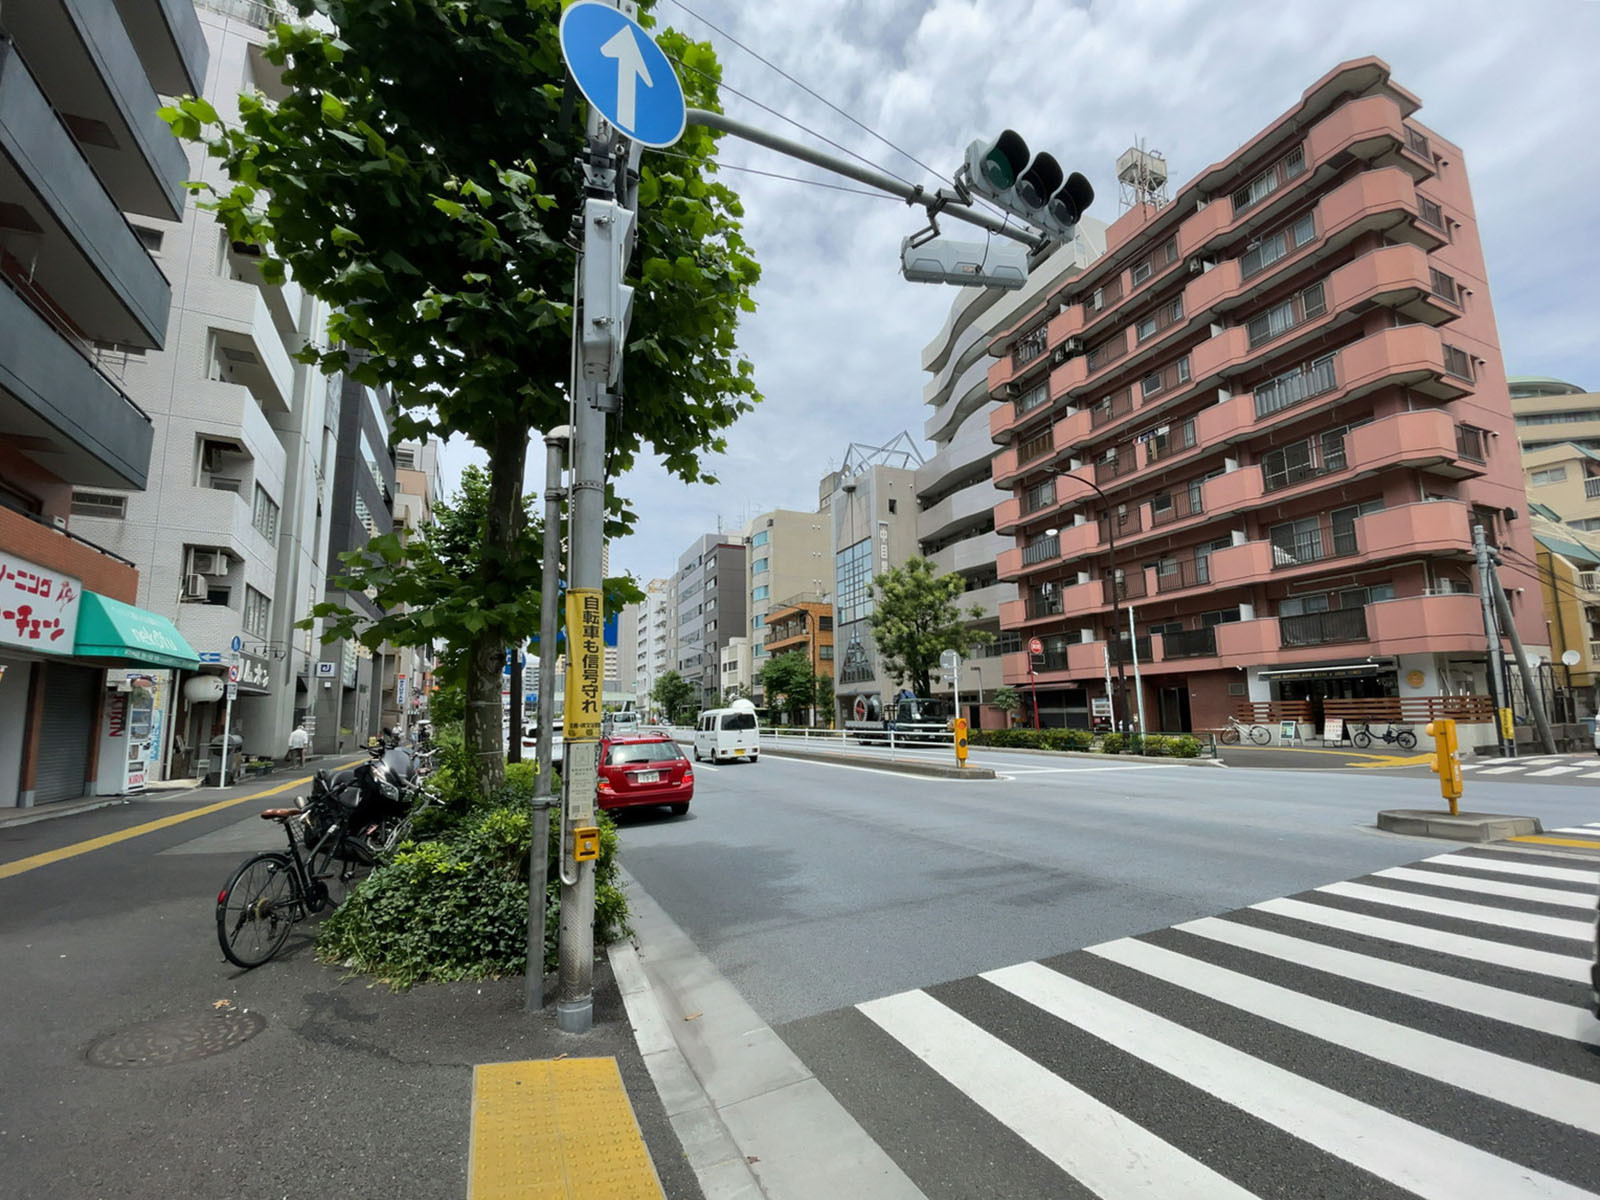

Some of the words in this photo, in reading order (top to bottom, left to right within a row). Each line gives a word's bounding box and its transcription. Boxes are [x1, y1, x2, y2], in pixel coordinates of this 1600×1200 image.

[582, 596, 600, 713] 自転車も信号守れ
